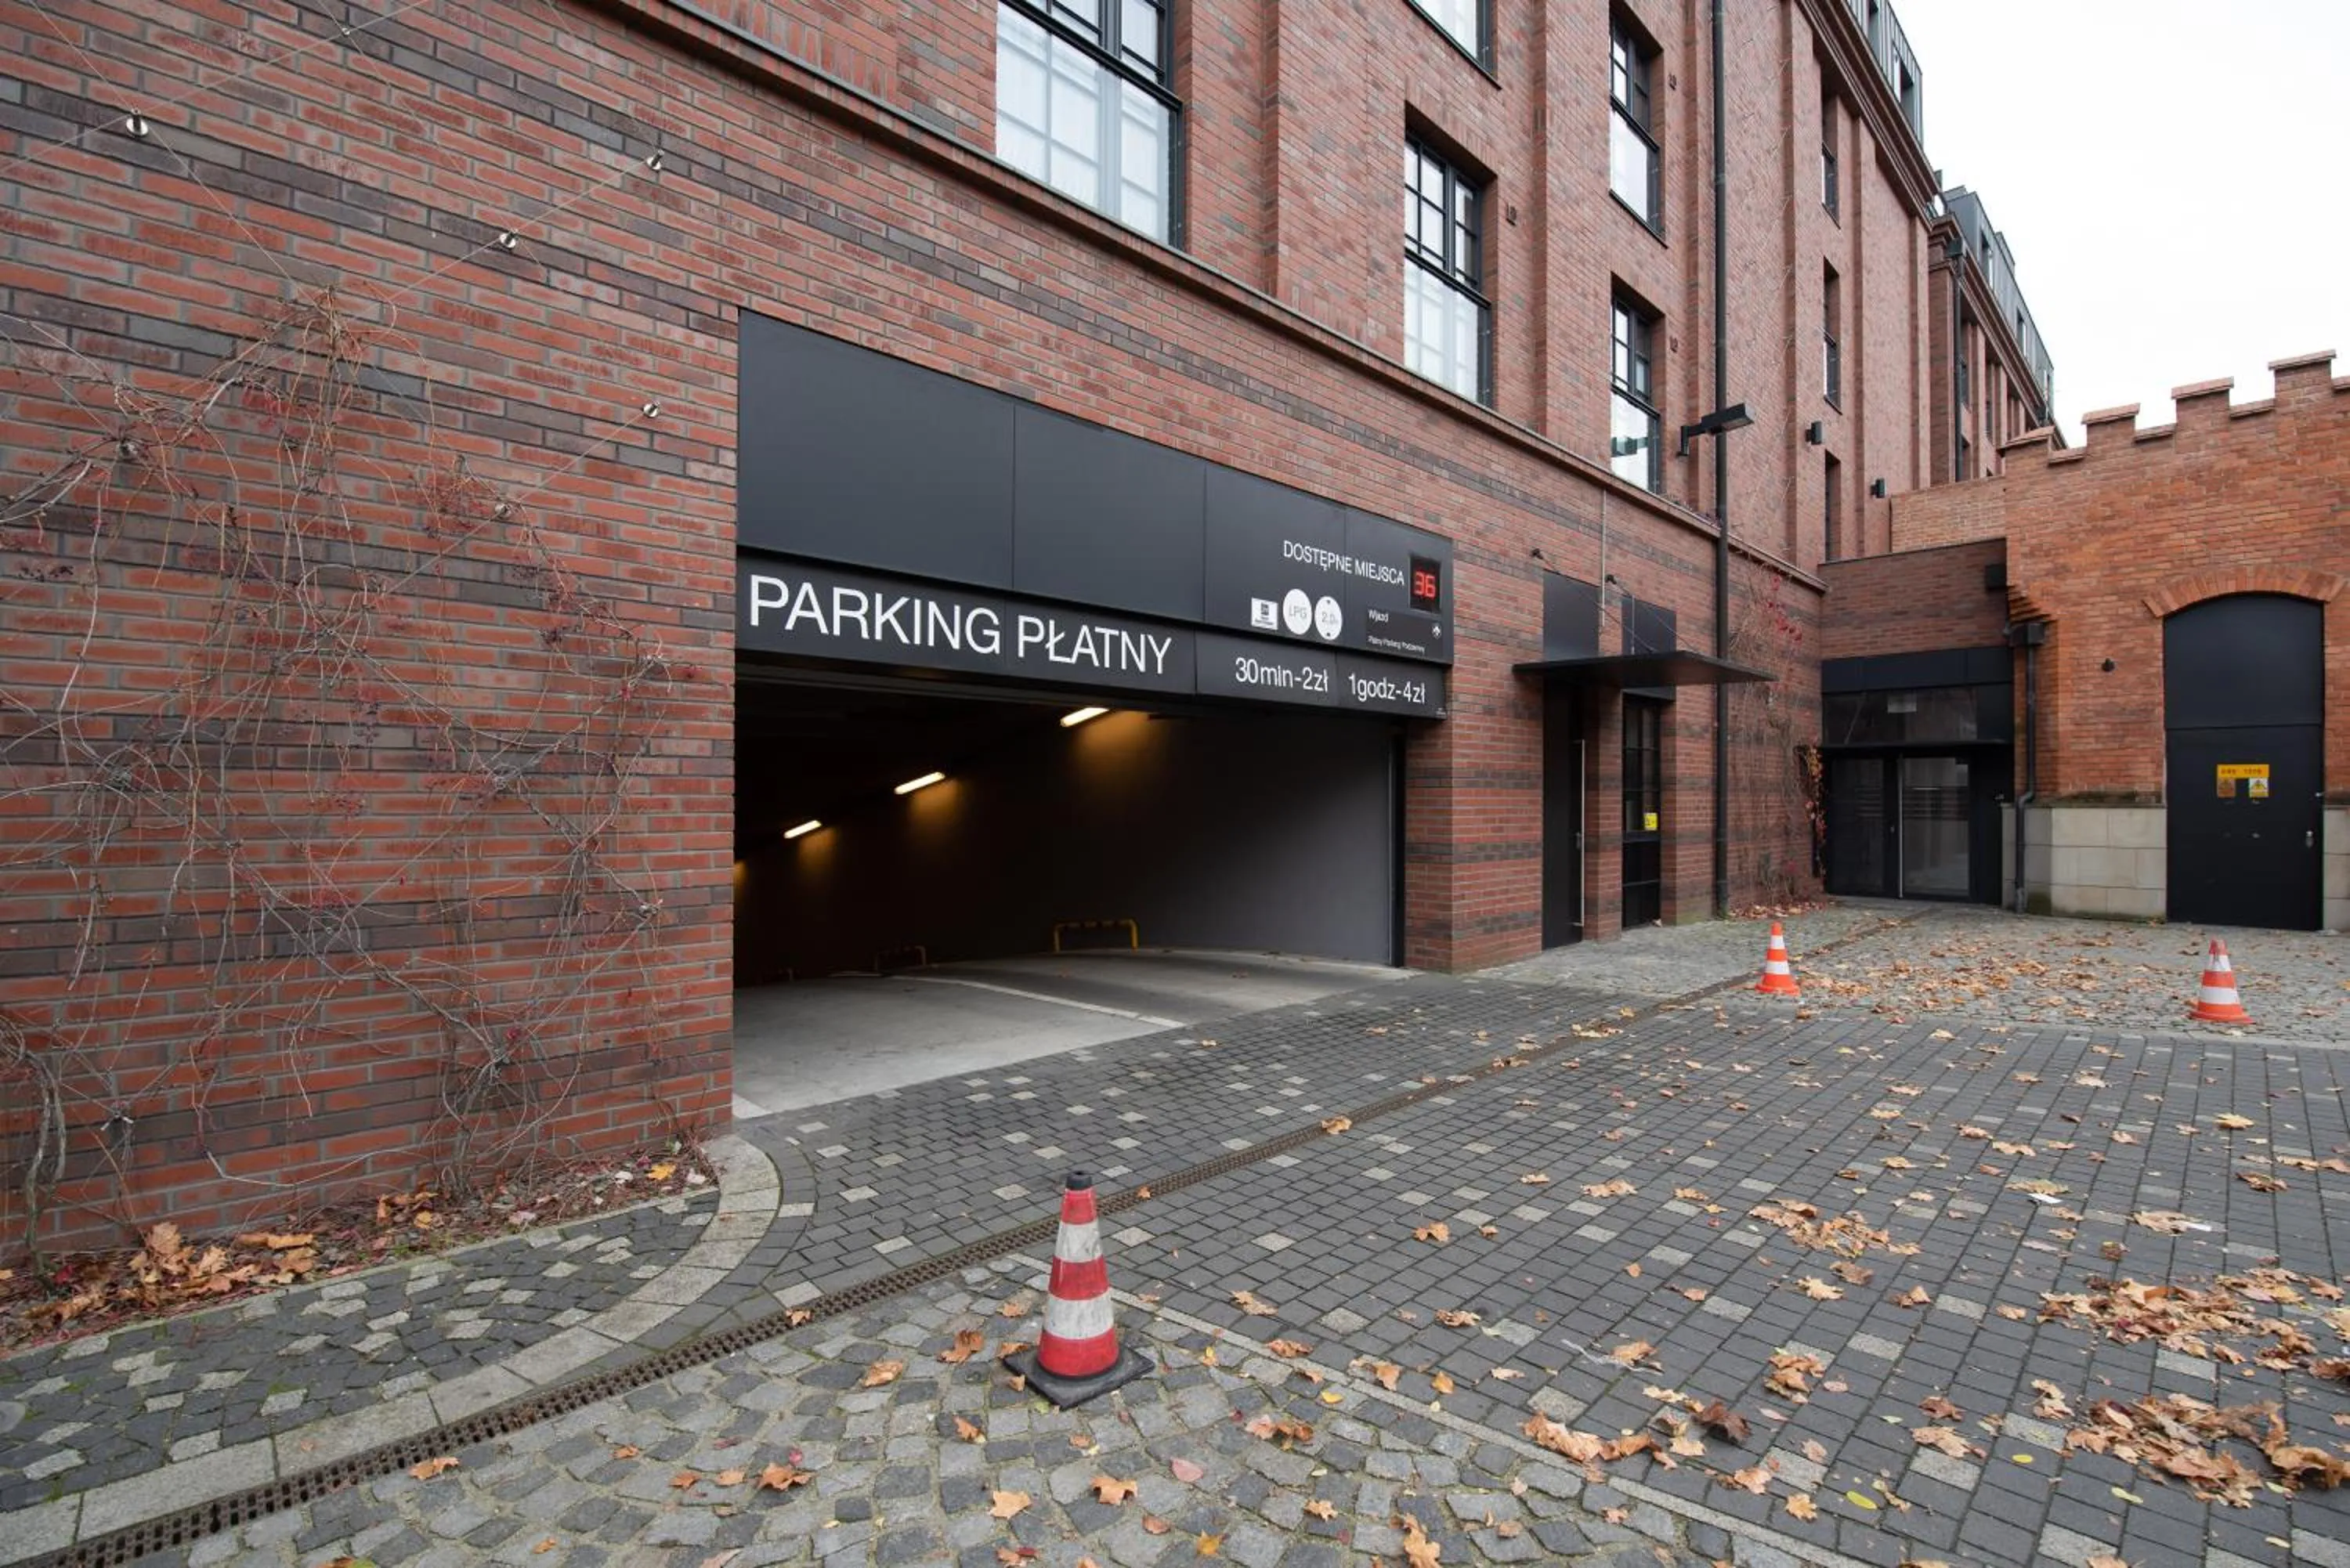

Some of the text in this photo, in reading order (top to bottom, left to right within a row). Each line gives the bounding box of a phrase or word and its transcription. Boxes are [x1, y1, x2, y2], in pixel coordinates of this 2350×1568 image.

[1283, 540, 1405, 586] DOSTĘPNE MIEJSCA
[1413, 570, 1437, 599] 36
[750, 574, 1172, 674] PARKING PŁATNY
[1289, 605, 1307, 620] LPG
